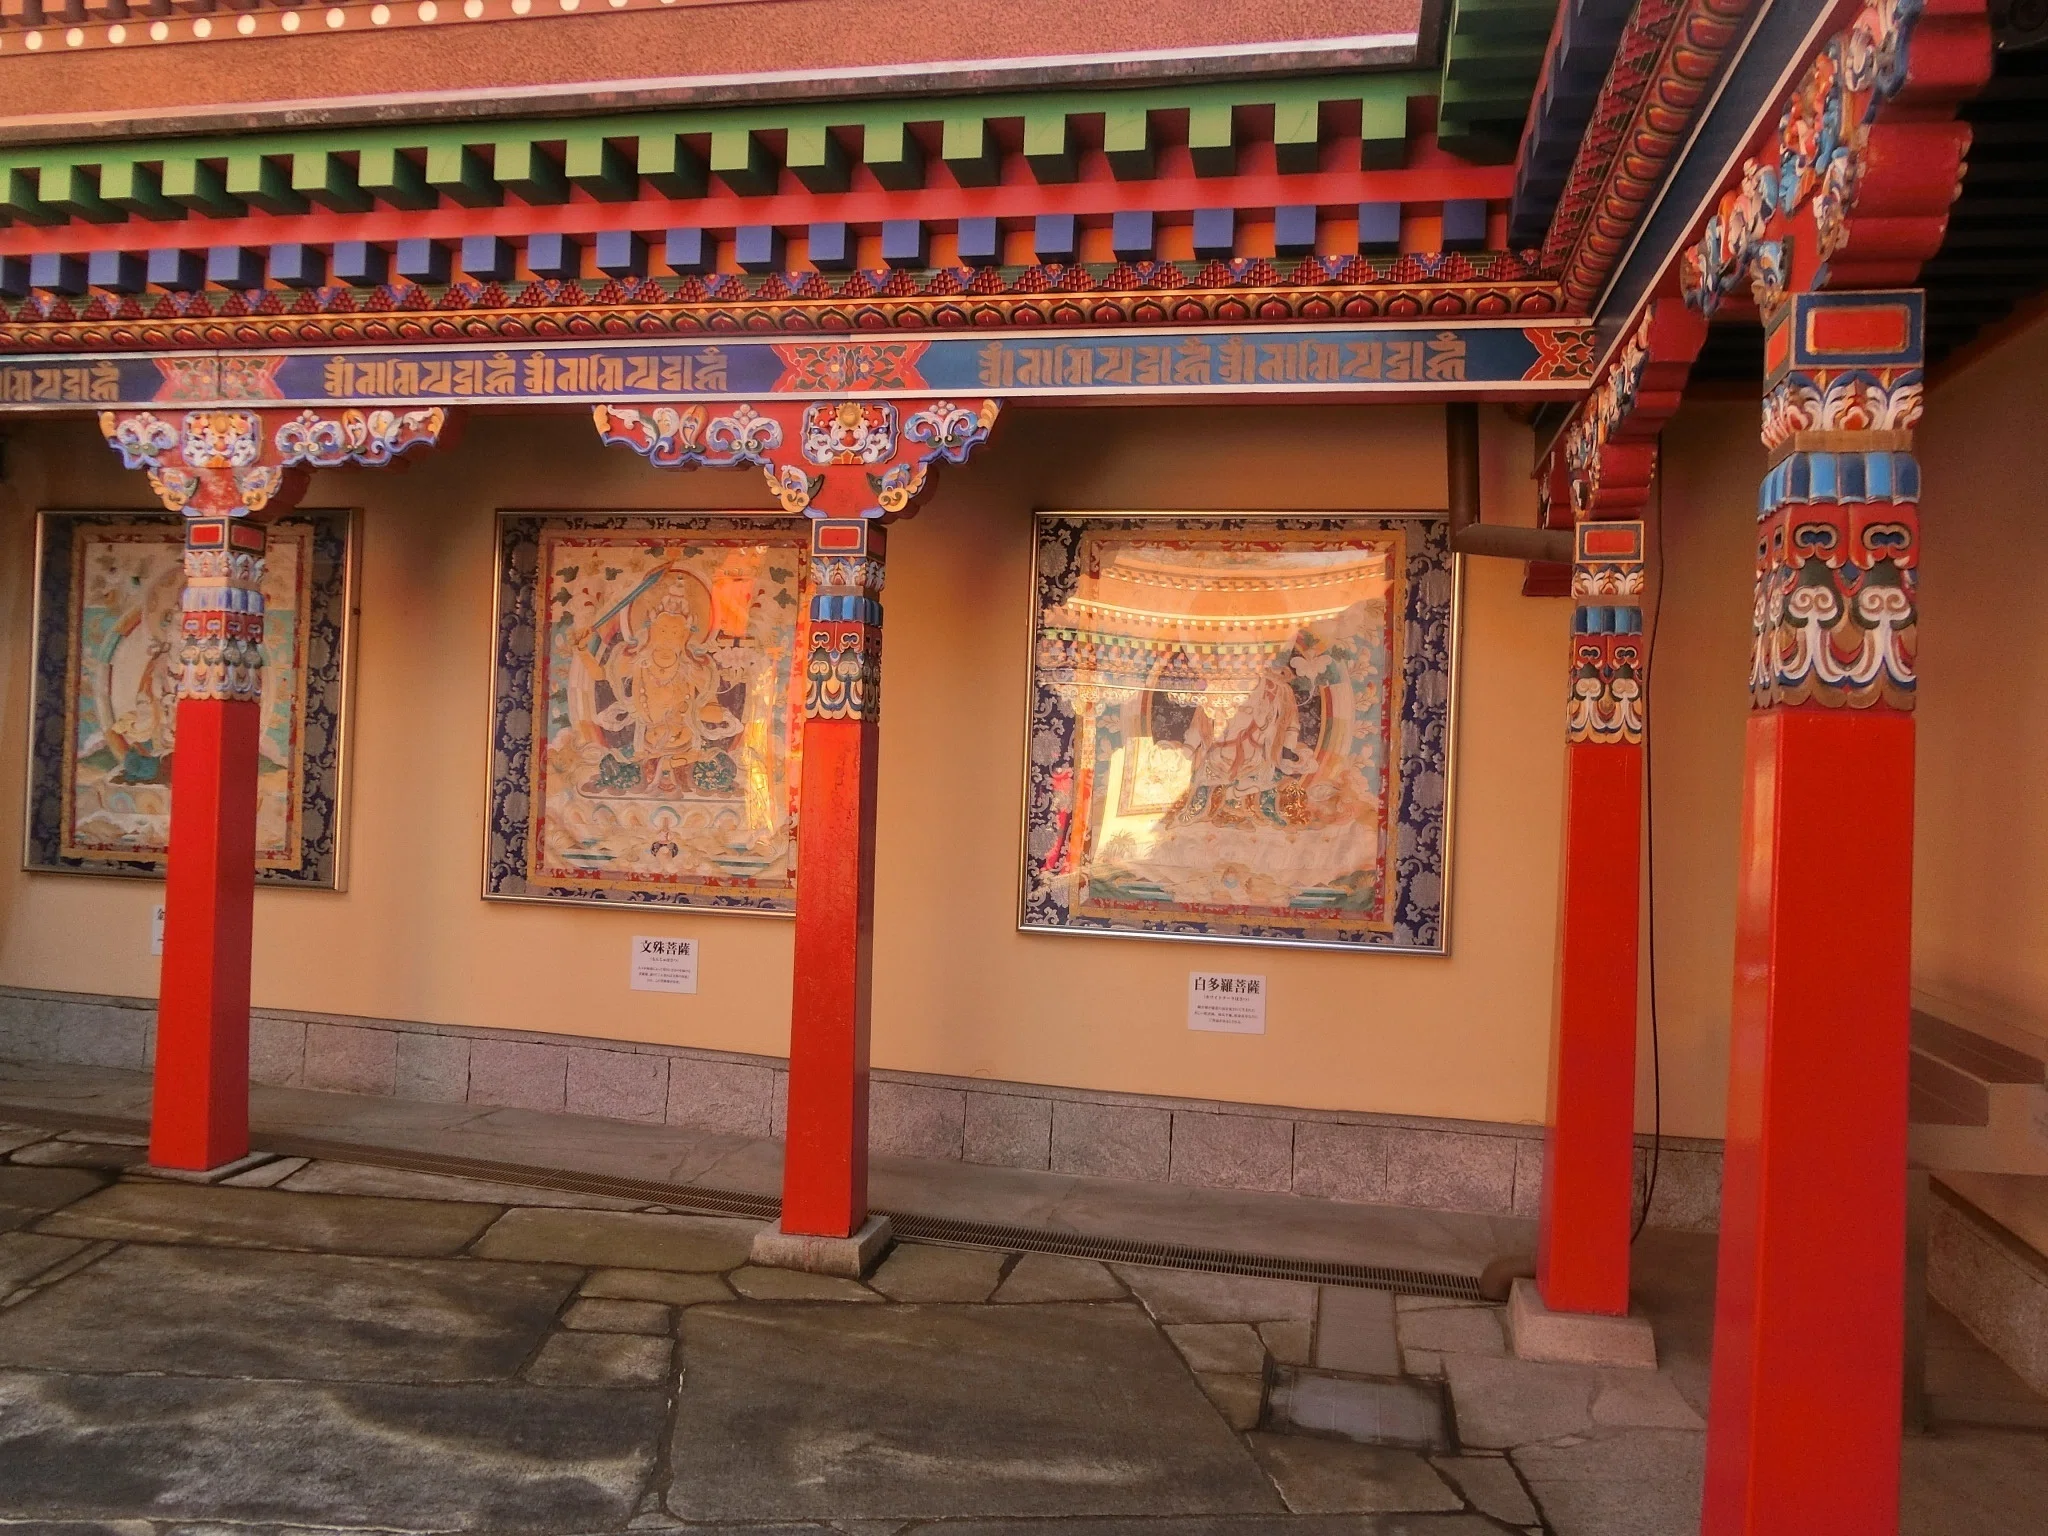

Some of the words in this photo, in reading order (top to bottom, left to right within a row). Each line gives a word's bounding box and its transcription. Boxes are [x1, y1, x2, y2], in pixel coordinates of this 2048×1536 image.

[640, 940, 691, 956] 文殊菩薩
[1194, 976, 1260, 995] 白多羅菩薩
